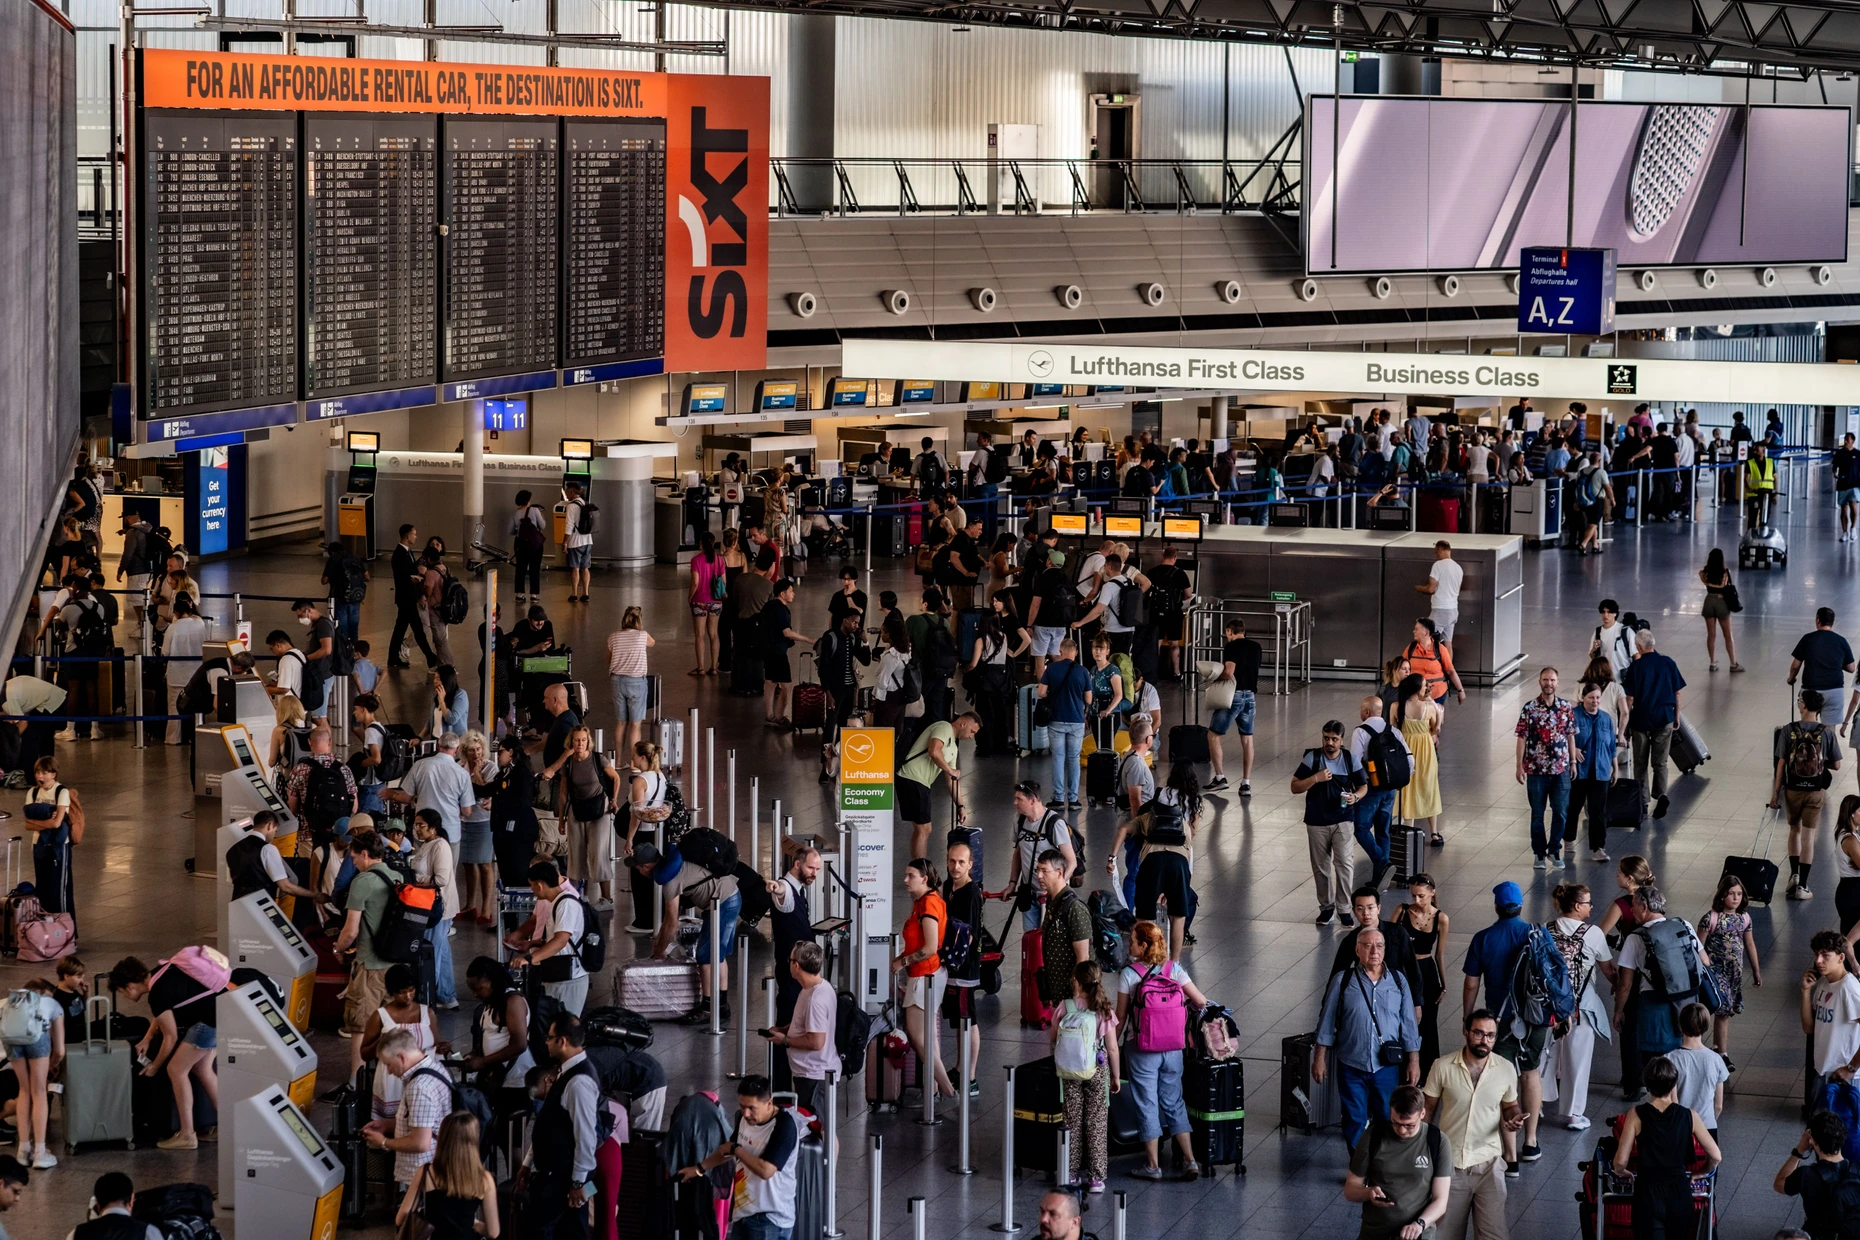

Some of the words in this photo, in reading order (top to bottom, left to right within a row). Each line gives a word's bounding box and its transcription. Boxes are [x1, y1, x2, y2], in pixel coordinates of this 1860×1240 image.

[186, 60, 223, 98] FOR
[229, 62, 254, 99] AN
[260, 64, 369, 102] AFFORDABLE
[374, 68, 432, 103] RENTAL
[436, 71, 471, 110] CAR,
[475, 73, 502, 104] THE
[506, 74, 594, 107] DESTINATION
[598, 77, 609, 108] IS
[613, 78, 643, 108] SIXT.
[679, 106, 748, 339] SIXT
[1532, 255, 1558, 263] Terminal
[1531, 268, 1567, 278] Abflughalle
[1530, 277, 1564, 286] Departures
[1528, 296, 1575, 327] A,Z
[1070, 356, 1181, 377] Lufthansa
[1188, 359, 1237, 379] First
[1242, 360, 1305, 380] Class
[1367, 364, 1469, 384] Business
[1475, 366, 1539, 387] Class
[492, 413, 502, 428] 11
[513, 413, 524, 428] 11
[408, 459, 449, 468] Lufthansa
[498, 462, 536, 470] Business
[538, 463, 562, 472] Class
[209, 481, 219, 491] Get
[208, 495, 220, 507] your
[202, 507, 226, 518] currency
[845, 770, 889, 779] Lufthansa
[845, 788, 885, 797] Economy
[1816, 990, 1825, 1001] I
